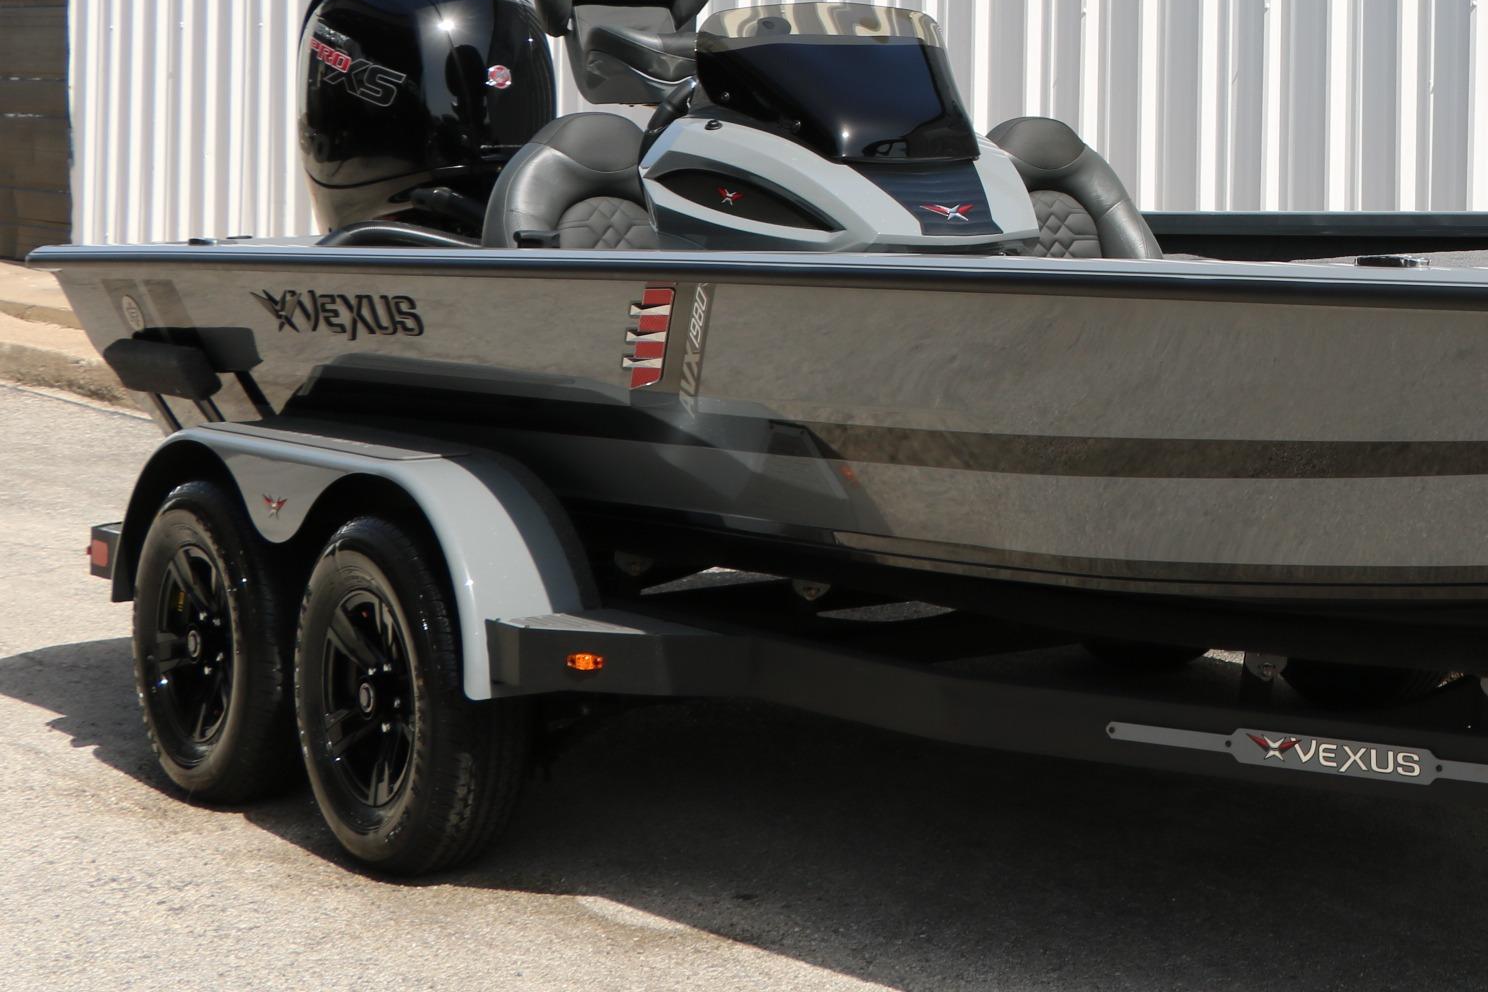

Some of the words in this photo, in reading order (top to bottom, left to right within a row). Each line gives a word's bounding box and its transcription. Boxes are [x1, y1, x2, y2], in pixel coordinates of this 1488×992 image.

[310, 36, 352, 74] PRO
[295, 289, 425, 341] VEXUS
[1291, 736, 1422, 777] VEXUS
